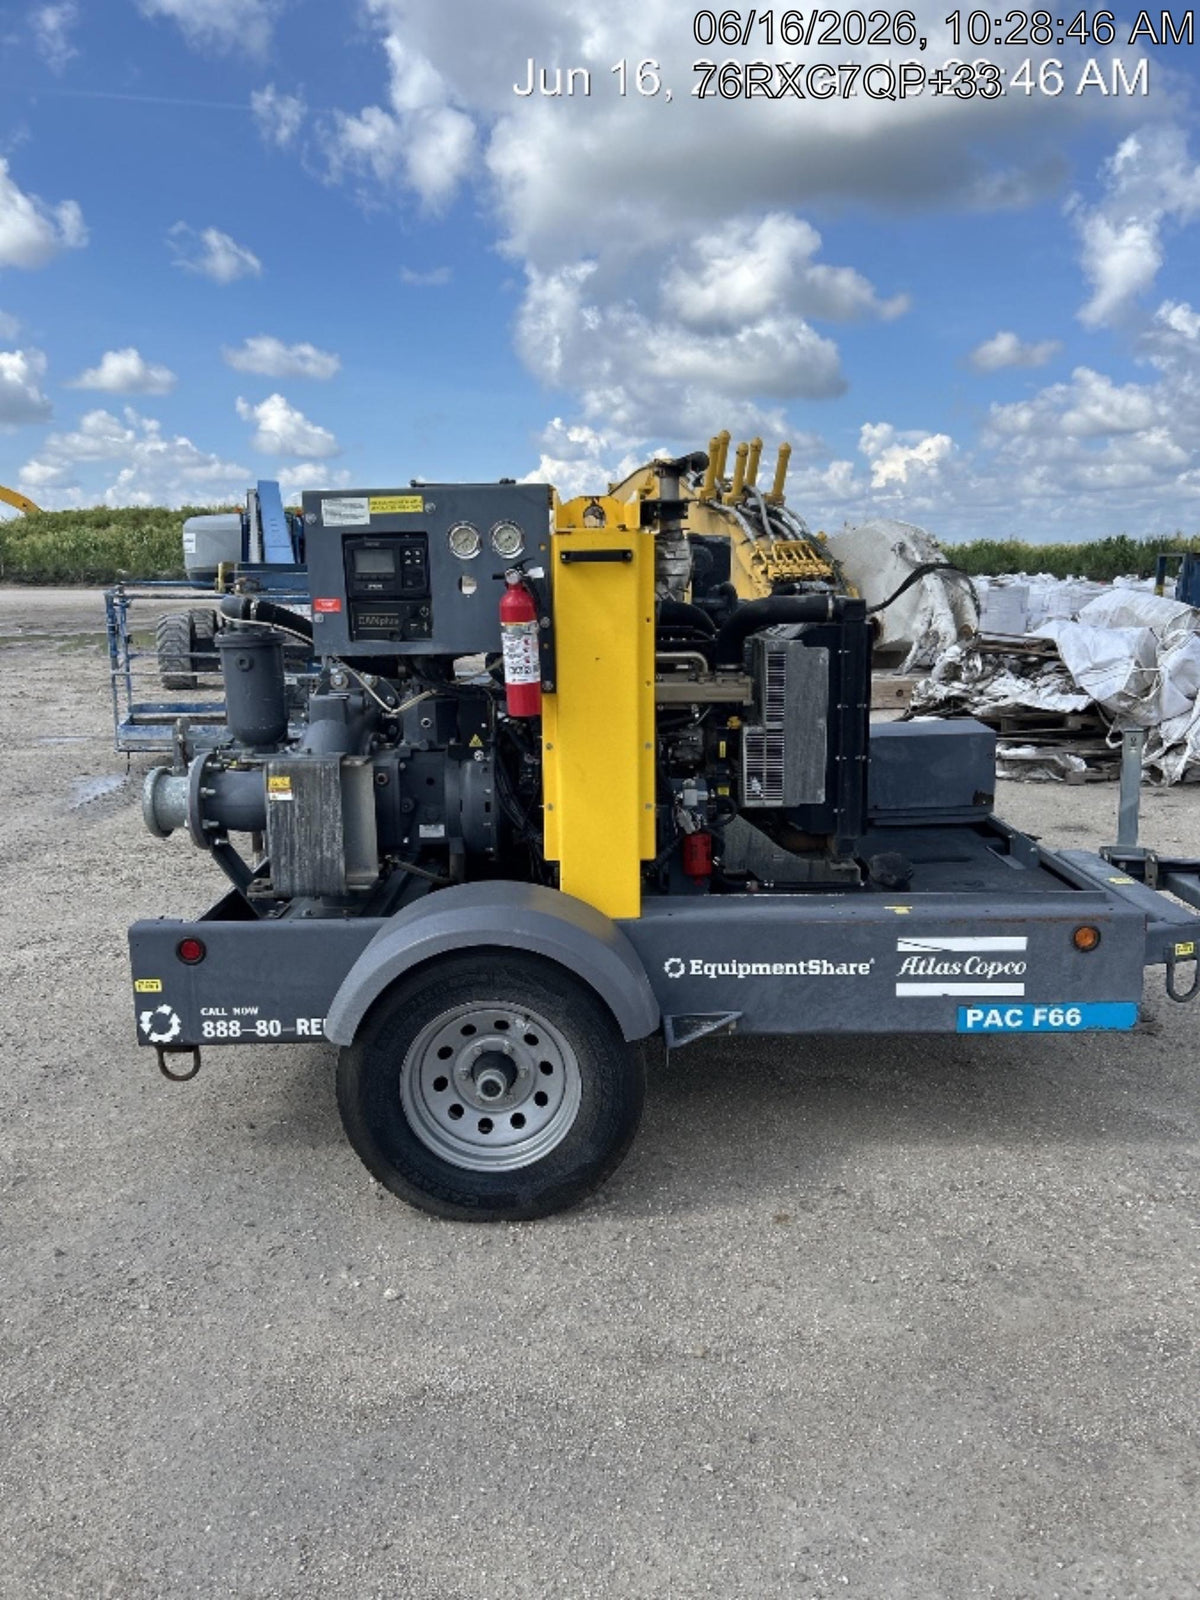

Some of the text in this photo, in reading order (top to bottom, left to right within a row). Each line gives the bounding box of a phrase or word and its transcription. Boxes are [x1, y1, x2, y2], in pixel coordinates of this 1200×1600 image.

[689, 958, 871, 979] EquipmentShare
[896, 956, 1027, 979] Atlas Copco
[200, 1006, 259, 1016] CALL NOW
[966, 1008, 1082, 1028] PAC F66
